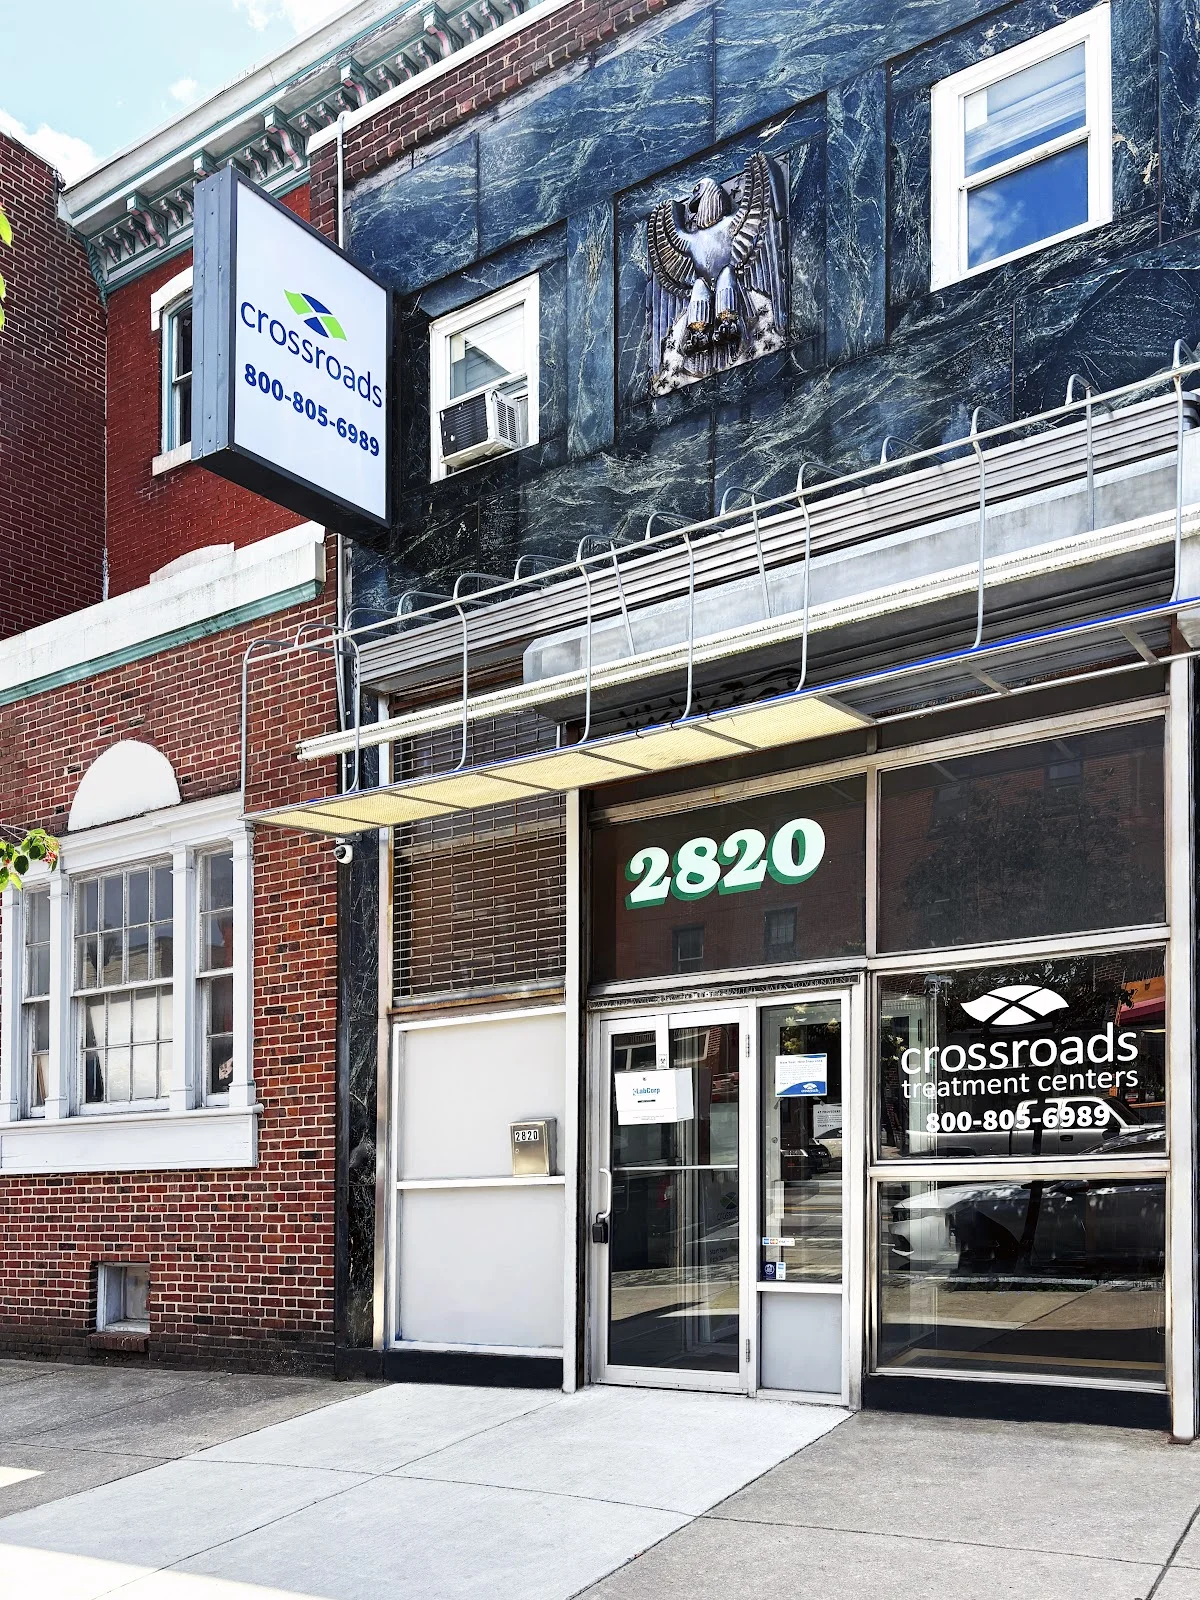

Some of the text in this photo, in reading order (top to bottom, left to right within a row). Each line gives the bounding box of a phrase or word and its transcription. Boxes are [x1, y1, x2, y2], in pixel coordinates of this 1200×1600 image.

[240, 301, 383, 408] crossroads
[244, 363, 379, 457] 800-805-6989
[624, 817, 826, 911] 2820
[792, 976, 852, 989] GOVERNMENT
[900, 1021, 1139, 1075] crossroads
[636, 1087, 661, 1095] LabCorp
[901, 1069, 1139, 1100] treatment centers
[925, 1105, 1110, 1133] 800-805-6989
[515, 1130, 538, 1141] 2820
